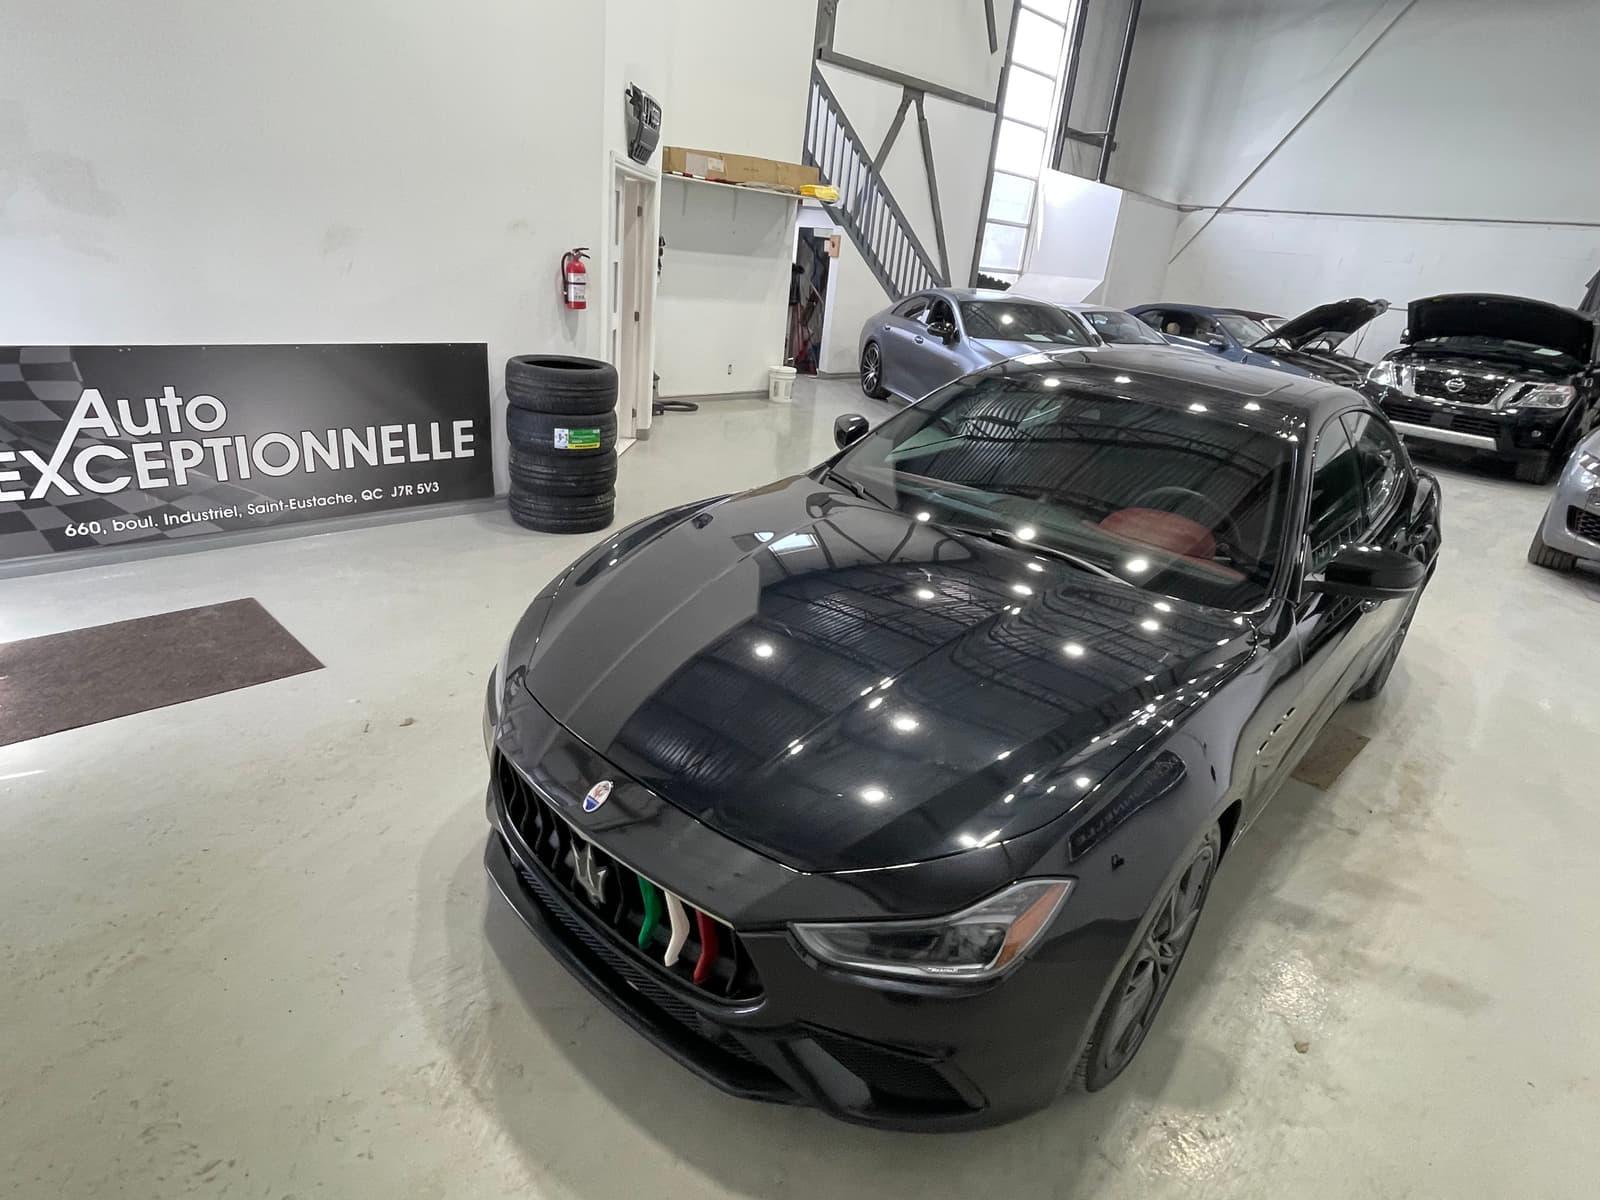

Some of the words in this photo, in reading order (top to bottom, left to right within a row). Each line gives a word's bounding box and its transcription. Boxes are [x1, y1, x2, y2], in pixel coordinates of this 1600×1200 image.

[66, 386, 227, 437] Auto
[0, 419, 475, 501] EXCEPTIONNELLE
[65, 521, 107, 537] 660,
[113, 515, 158, 532] boul.
[164, 506, 242, 526] Industriel,
[247, 493, 358, 515] Saint-Eustache,
[361, 488, 383, 501] QC
[391, 485, 413, 498] J7R
[417, 481, 440, 494] 5V3
